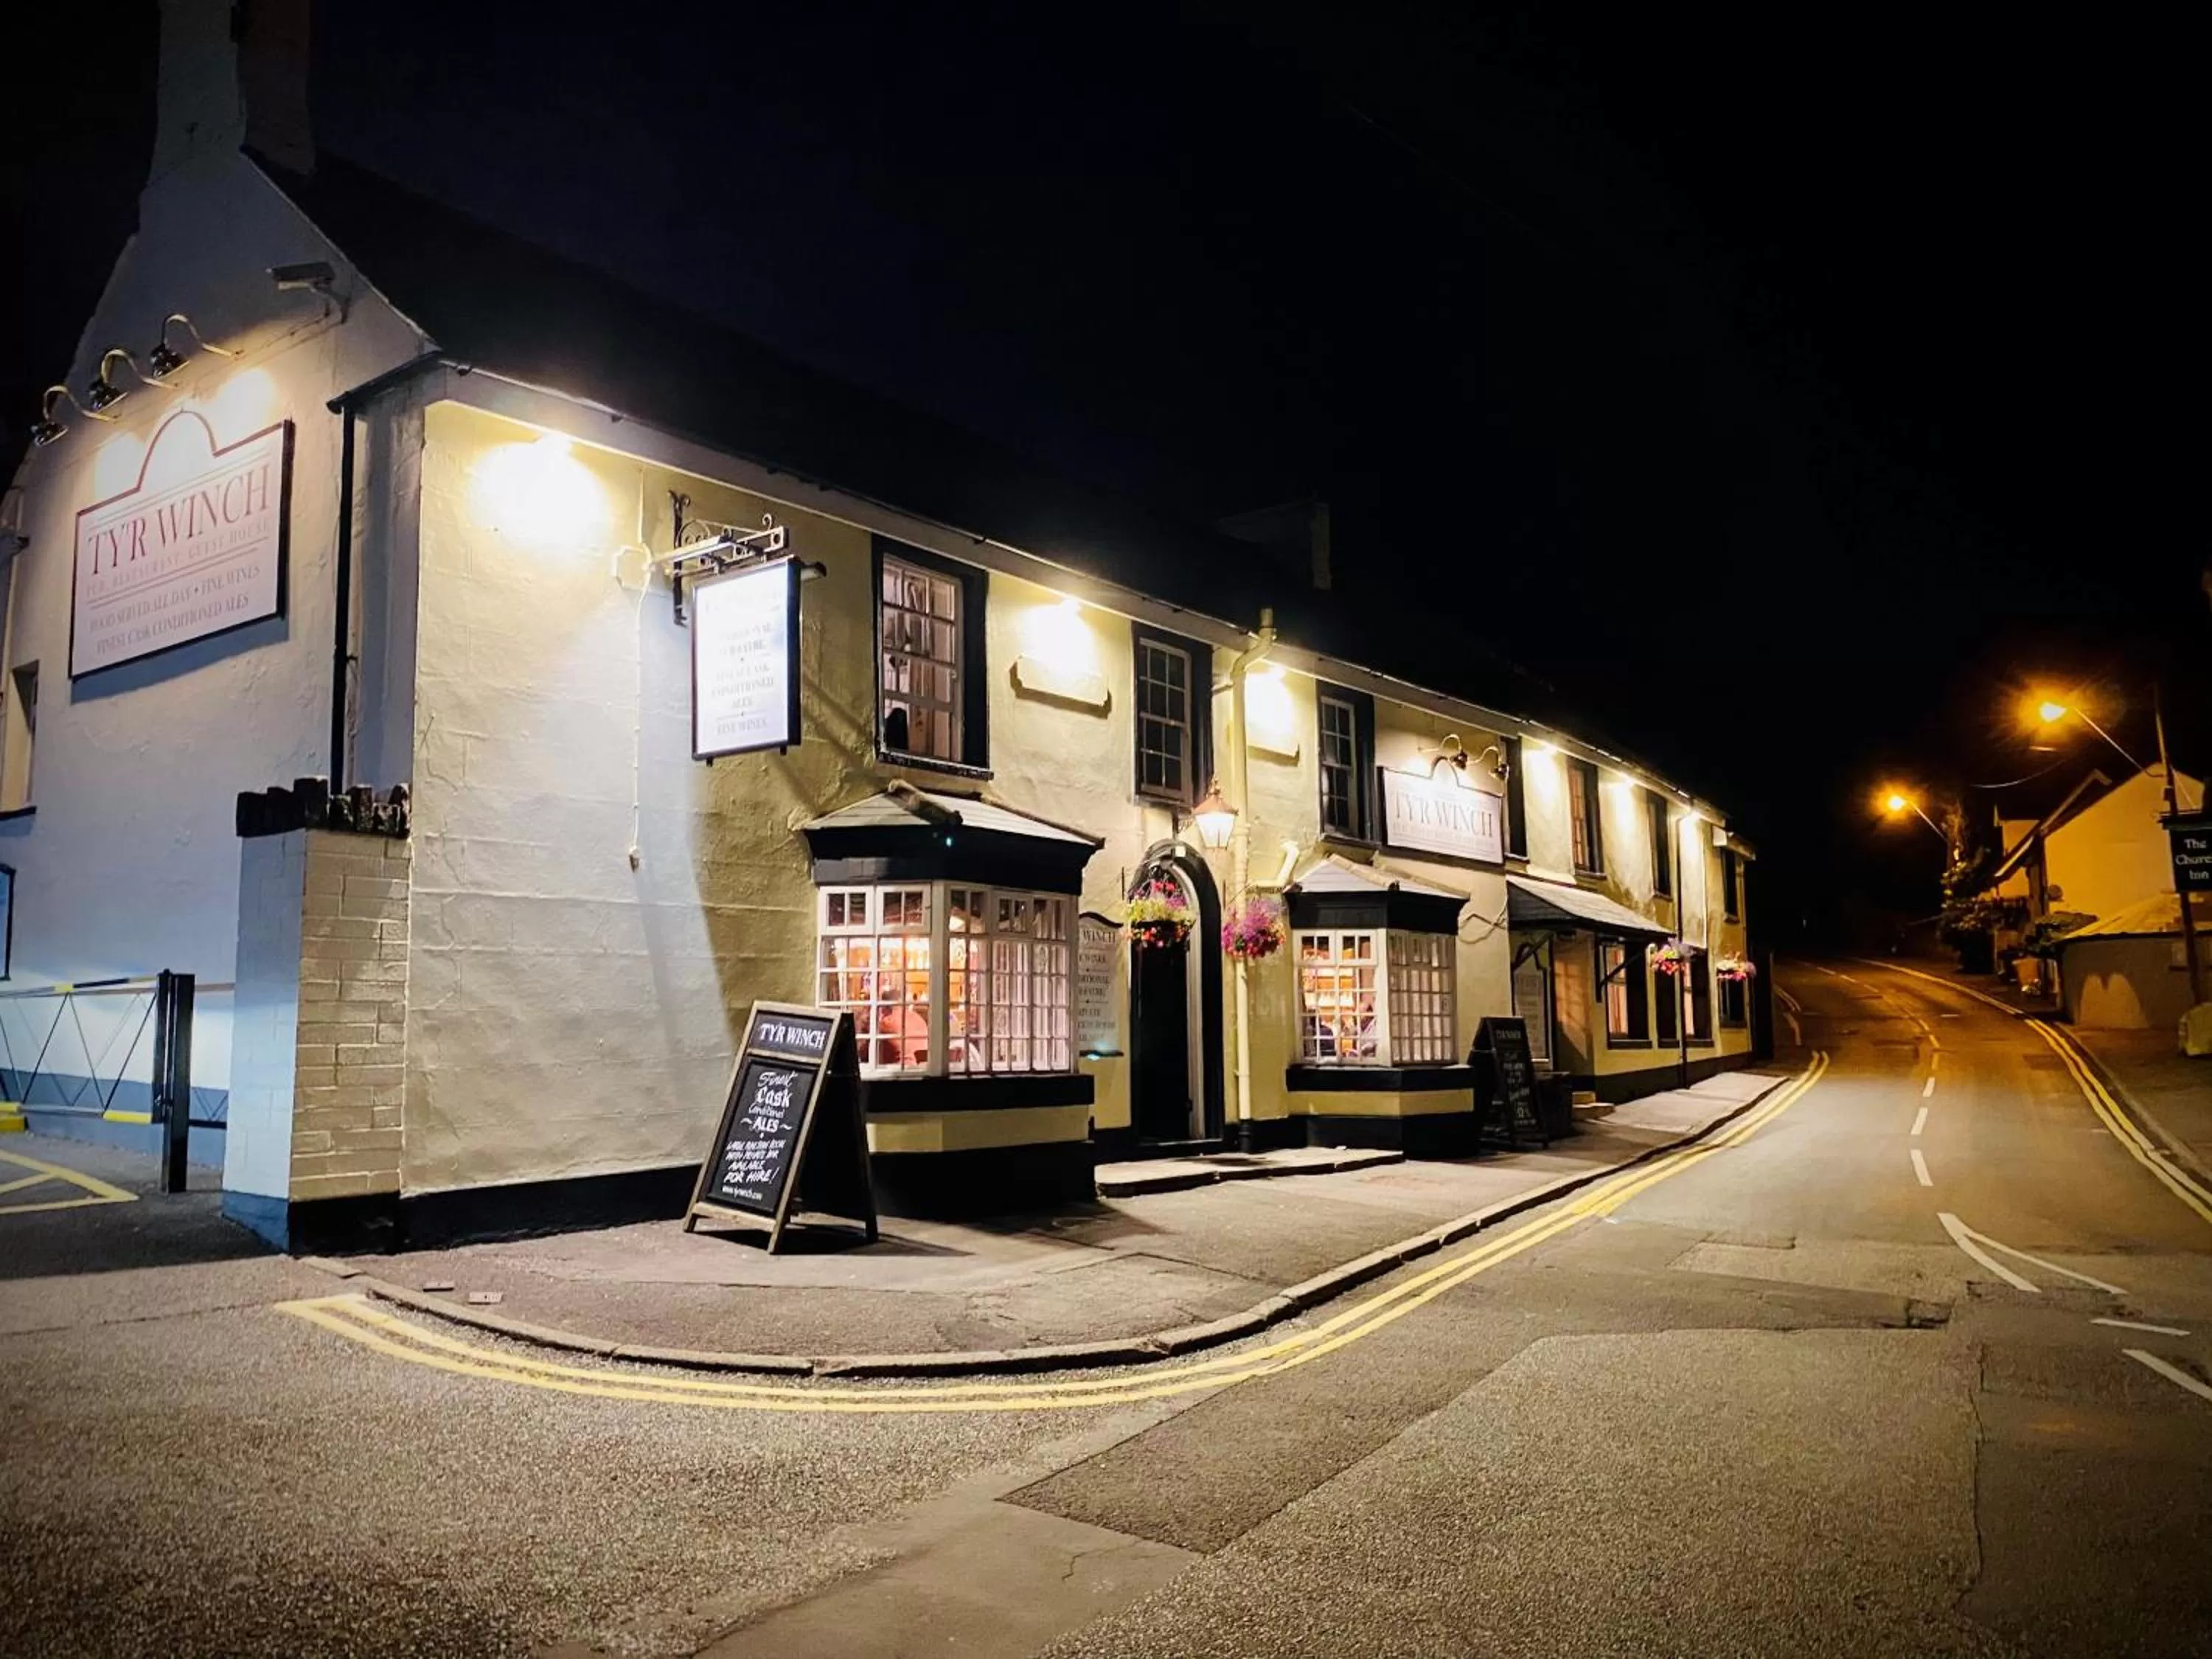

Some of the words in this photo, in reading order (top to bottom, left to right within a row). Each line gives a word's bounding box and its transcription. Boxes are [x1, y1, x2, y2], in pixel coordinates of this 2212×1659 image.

[157, 464, 271, 547] WINCH
[117, 600, 150, 624] SERVED
[151, 594, 169, 613] ALL
[171, 588, 190, 604] DAY
[201, 575, 224, 595] FINE
[226, 566, 260, 585] WINES
[153, 601, 221, 636] CONDITIONED
[226, 592, 248, 612] ALES
[1435, 801, 1493, 838] WINCH
[2183, 838, 2208, 849] The
[1082, 929, 1116, 944] WINCH
[787, 1026, 827, 1049] WINCH
[757, 1071, 798, 1087] Finest
[756, 1085, 793, 1107] Cask
[752, 1116, 779, 1133] ALES
[723, 1170, 745, 1183] FOR
[745, 1166, 779, 1184] HIRE!
[728, 1160, 765, 1171] AVAILABLE
